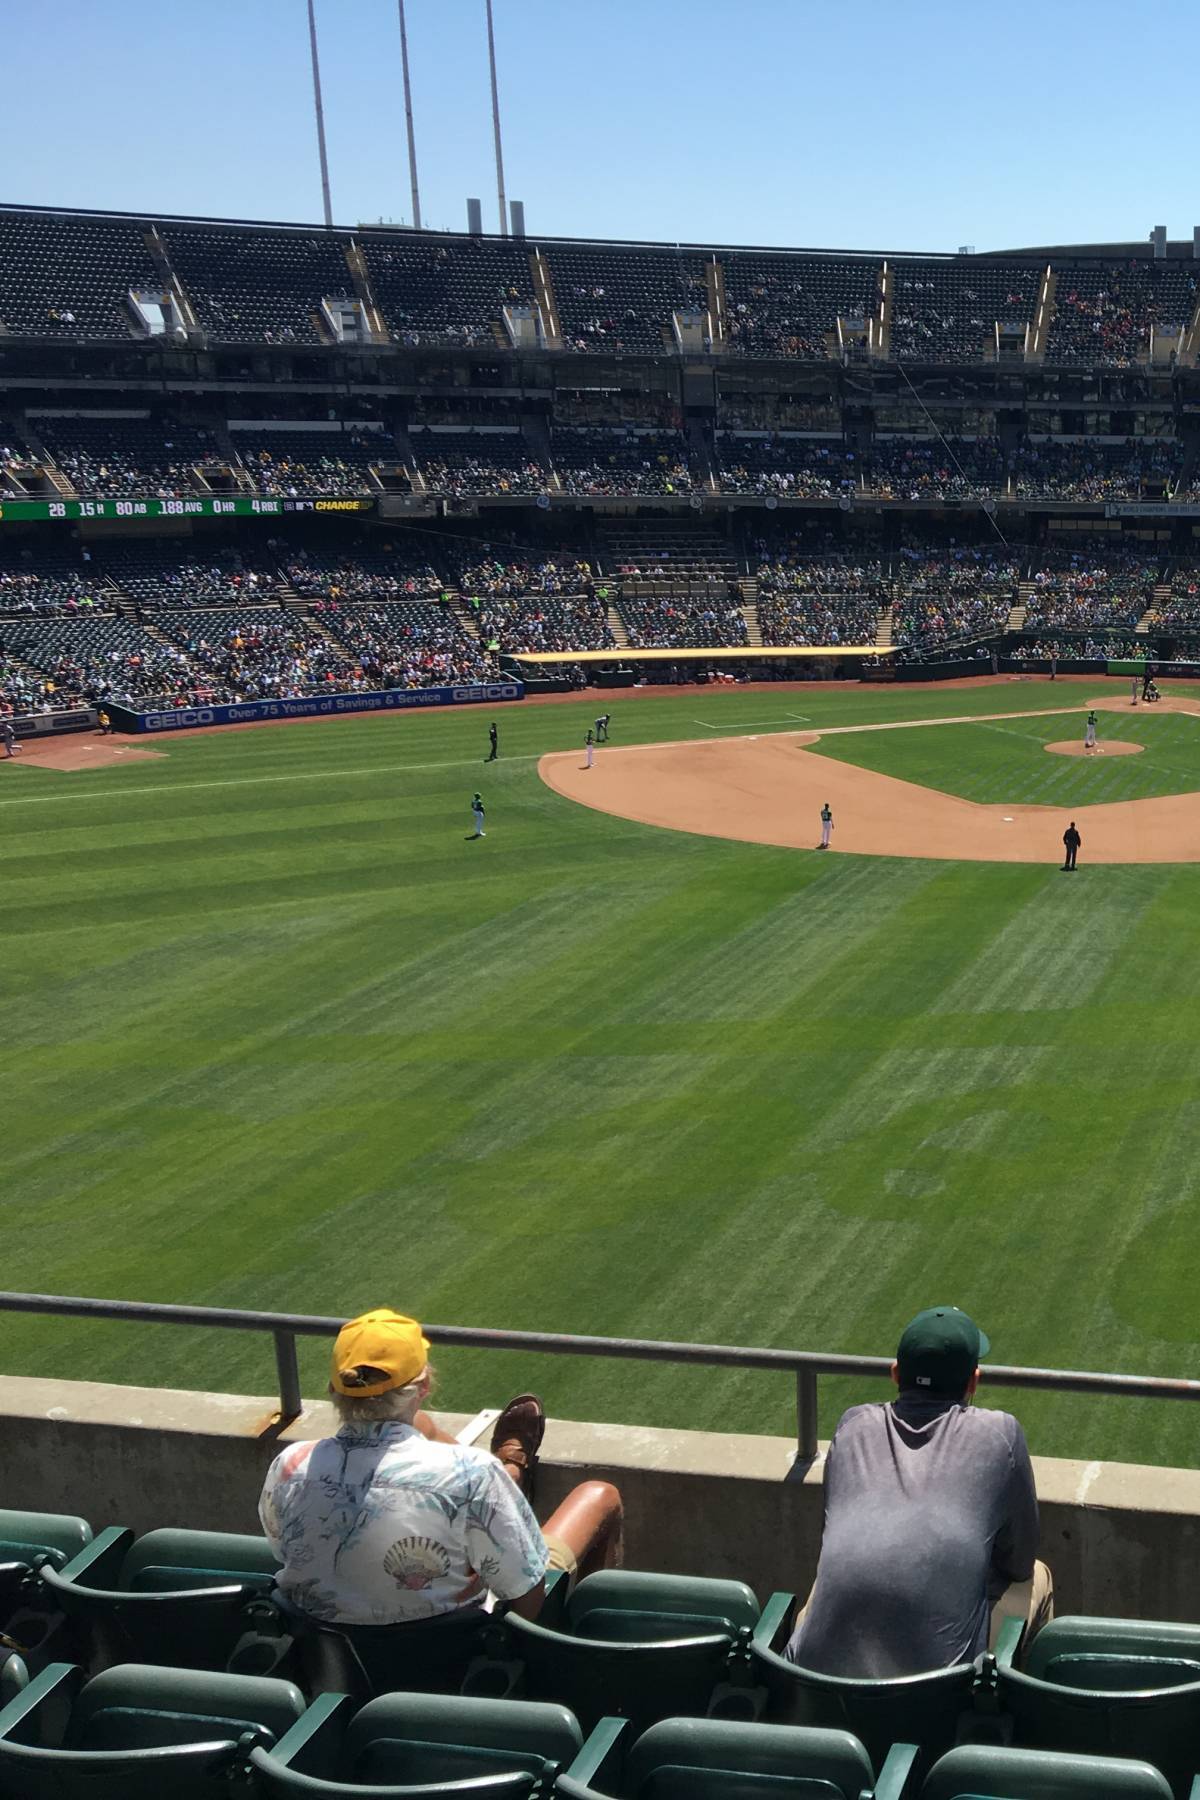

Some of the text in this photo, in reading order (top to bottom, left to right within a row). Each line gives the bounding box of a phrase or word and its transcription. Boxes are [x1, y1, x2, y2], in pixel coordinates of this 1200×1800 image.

[49, 503, 66, 516] 2B
[79, 502, 94, 516] 15
[116, 502, 132, 515] 80
[134, 503, 147, 514] AB
[158, 501, 183, 515] .188
[185, 501, 203, 512] AVG
[222, 502, 236, 512] HR
[251, 500, 260, 513] 4
[261, 501, 278, 512] RBI
[315, 501, 373, 511] CHANGE
[145, 710, 214, 729] GEICO
[228, 708, 257, 719] Over
[261, 705, 278, 716] 75
[282, 702, 317, 713] Years
[321, 700, 333, 711] of
[336, 698, 381, 709] Savings
[399, 692, 441, 703] Service
[452, 685, 518, 701] GEICO
